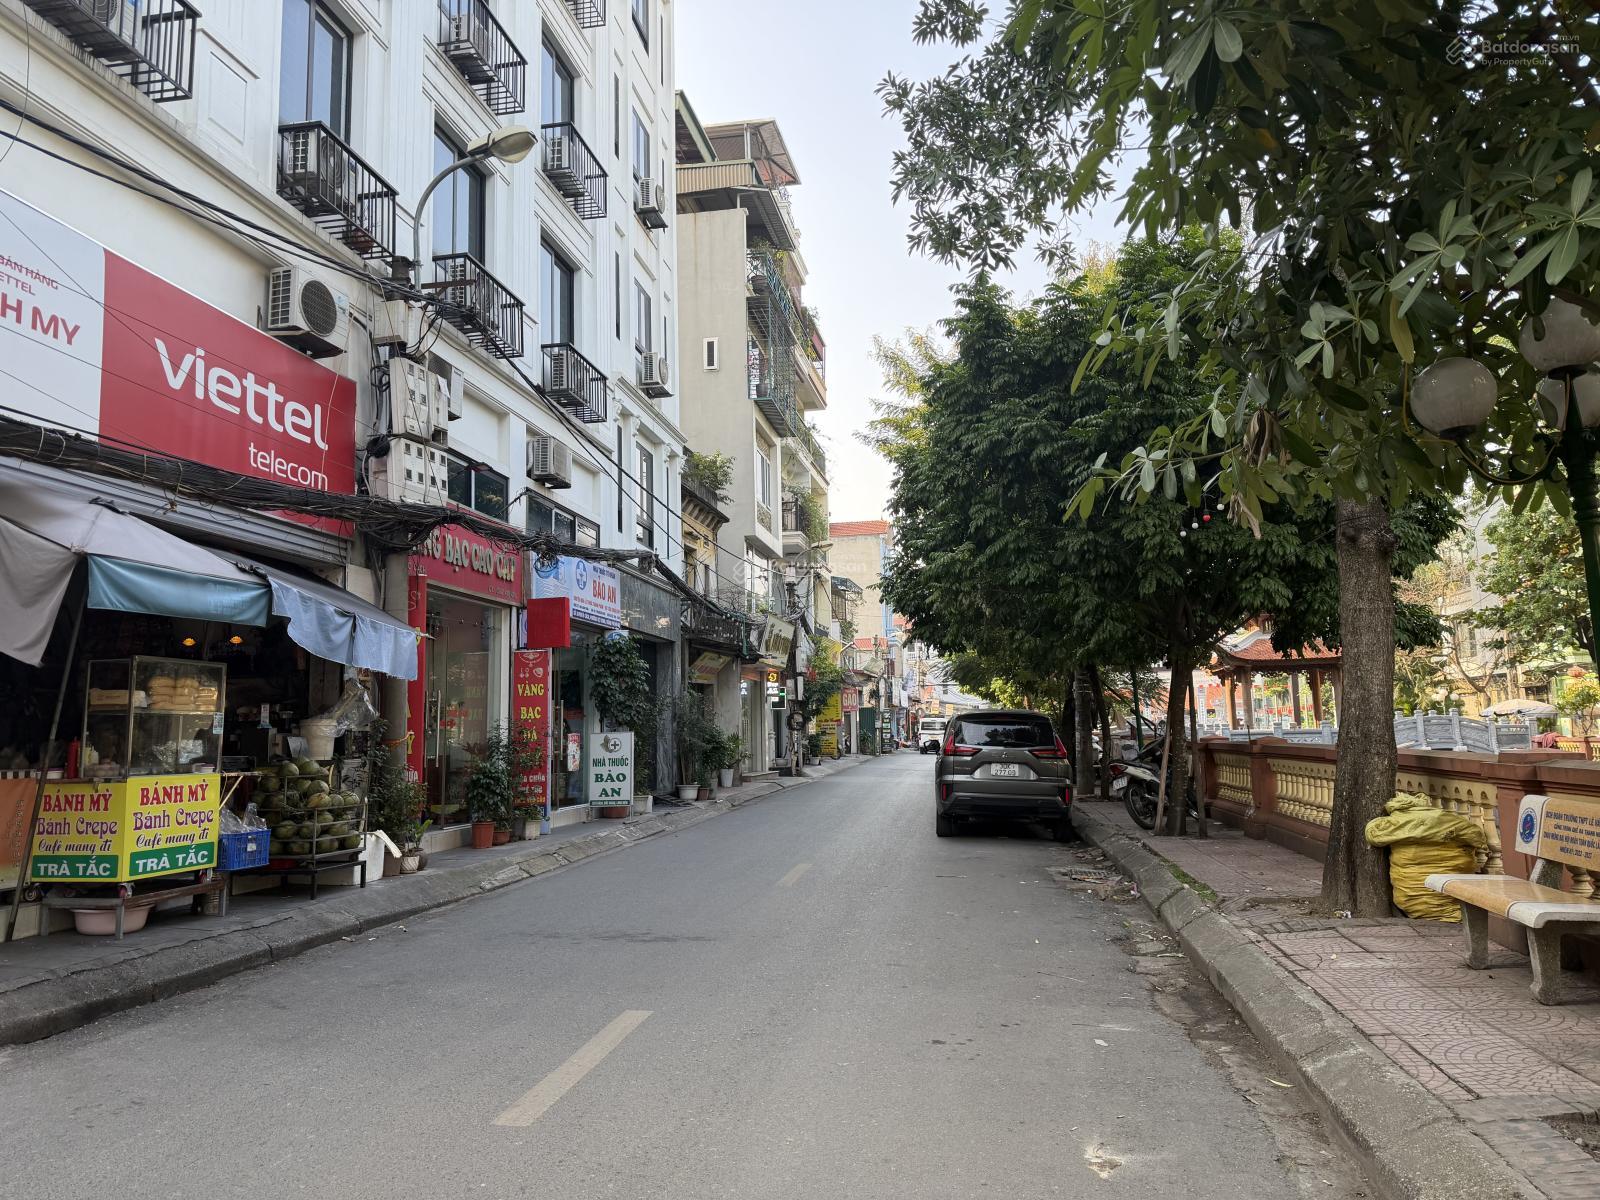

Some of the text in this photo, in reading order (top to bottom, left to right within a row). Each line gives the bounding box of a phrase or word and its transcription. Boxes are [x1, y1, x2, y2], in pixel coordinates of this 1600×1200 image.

[25, 267, 59, 290] HÀNG
[31, 305, 81, 346] MY
[154, 337, 329, 451] viettel
[249, 442, 328, 492] telecom
[445, 532, 470, 573] BẠC
[471, 542, 494, 575] CAO
[592, 575, 606, 601] BẢO
[607, 585, 617, 604] AN
[517, 681, 545, 696] VÀNG
[520, 706, 542, 723] BẠC
[592, 754, 629, 768] NHÀ THUỐC
[594, 769, 627, 783] BẢO
[42, 788, 85, 812] BÁNH
[140, 781, 184, 806] BÁNH
[599, 787, 622, 798] AN
[36, 816, 118, 839] Bánh Crepe
[132, 807, 214, 831] Bánh Crepe
[64, 842, 96, 855] mang
[99, 838, 112, 852] đi
[165, 831, 196, 844] mang
[198, 827, 210, 840] đi
[37, 855, 111, 876] TRÀ TẮC
[135, 844, 209, 873] TRÀ TẮC
